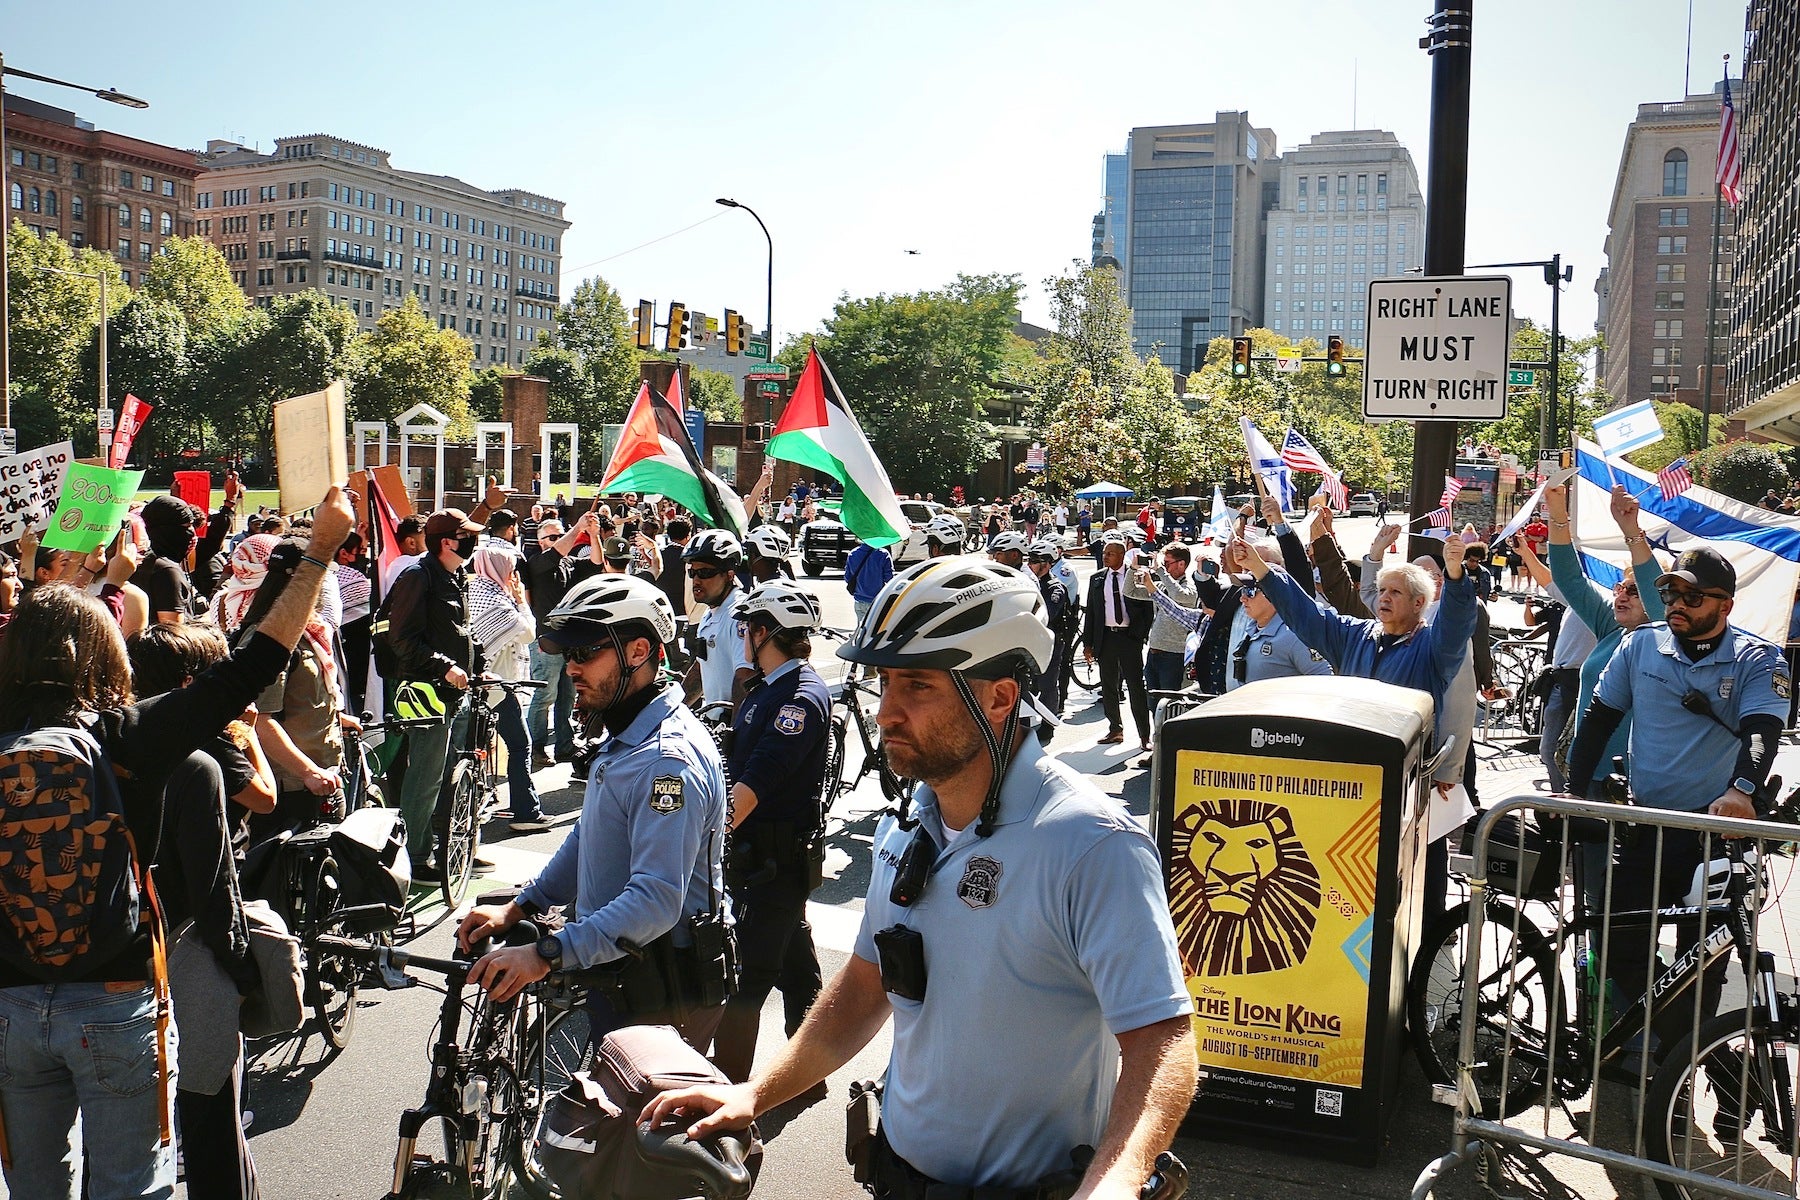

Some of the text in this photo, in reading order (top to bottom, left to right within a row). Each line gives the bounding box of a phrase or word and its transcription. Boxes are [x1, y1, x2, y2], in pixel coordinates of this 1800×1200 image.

[1377, 296, 1501, 319] RIGHT LANE
[758, 347, 765, 356] St
[1400, 336, 1475, 362] MUST
[1516, 373, 1528, 382] St
[1373, 379, 1499, 401] TURN RIGHT
[23, 458, 42, 474] are
[46, 453, 66, 467] no
[29, 484, 57, 503] must
[654, 618, 669, 639] POLICE
[1251, 727, 1305, 748] Bigbelly
[654, 784, 681, 795] POLICE
[1193, 768, 1363, 800] RETURNING TO PHILADELPHIA!
[966, 886, 986, 902] 1323
[1712, 928, 1729, 946] 77
[1200, 984, 1227, 998] Disney
[1195, 996, 1230, 1017] THE
[1206, 1025, 1326, 1049] THE WORLD'S #1 MUSICAL
[1202, 1038, 1237, 1056] AUGUST
[1308, 1054, 1319, 1068] 10
[1212, 1073, 1296, 1093] Kimmel Cultural Campus
